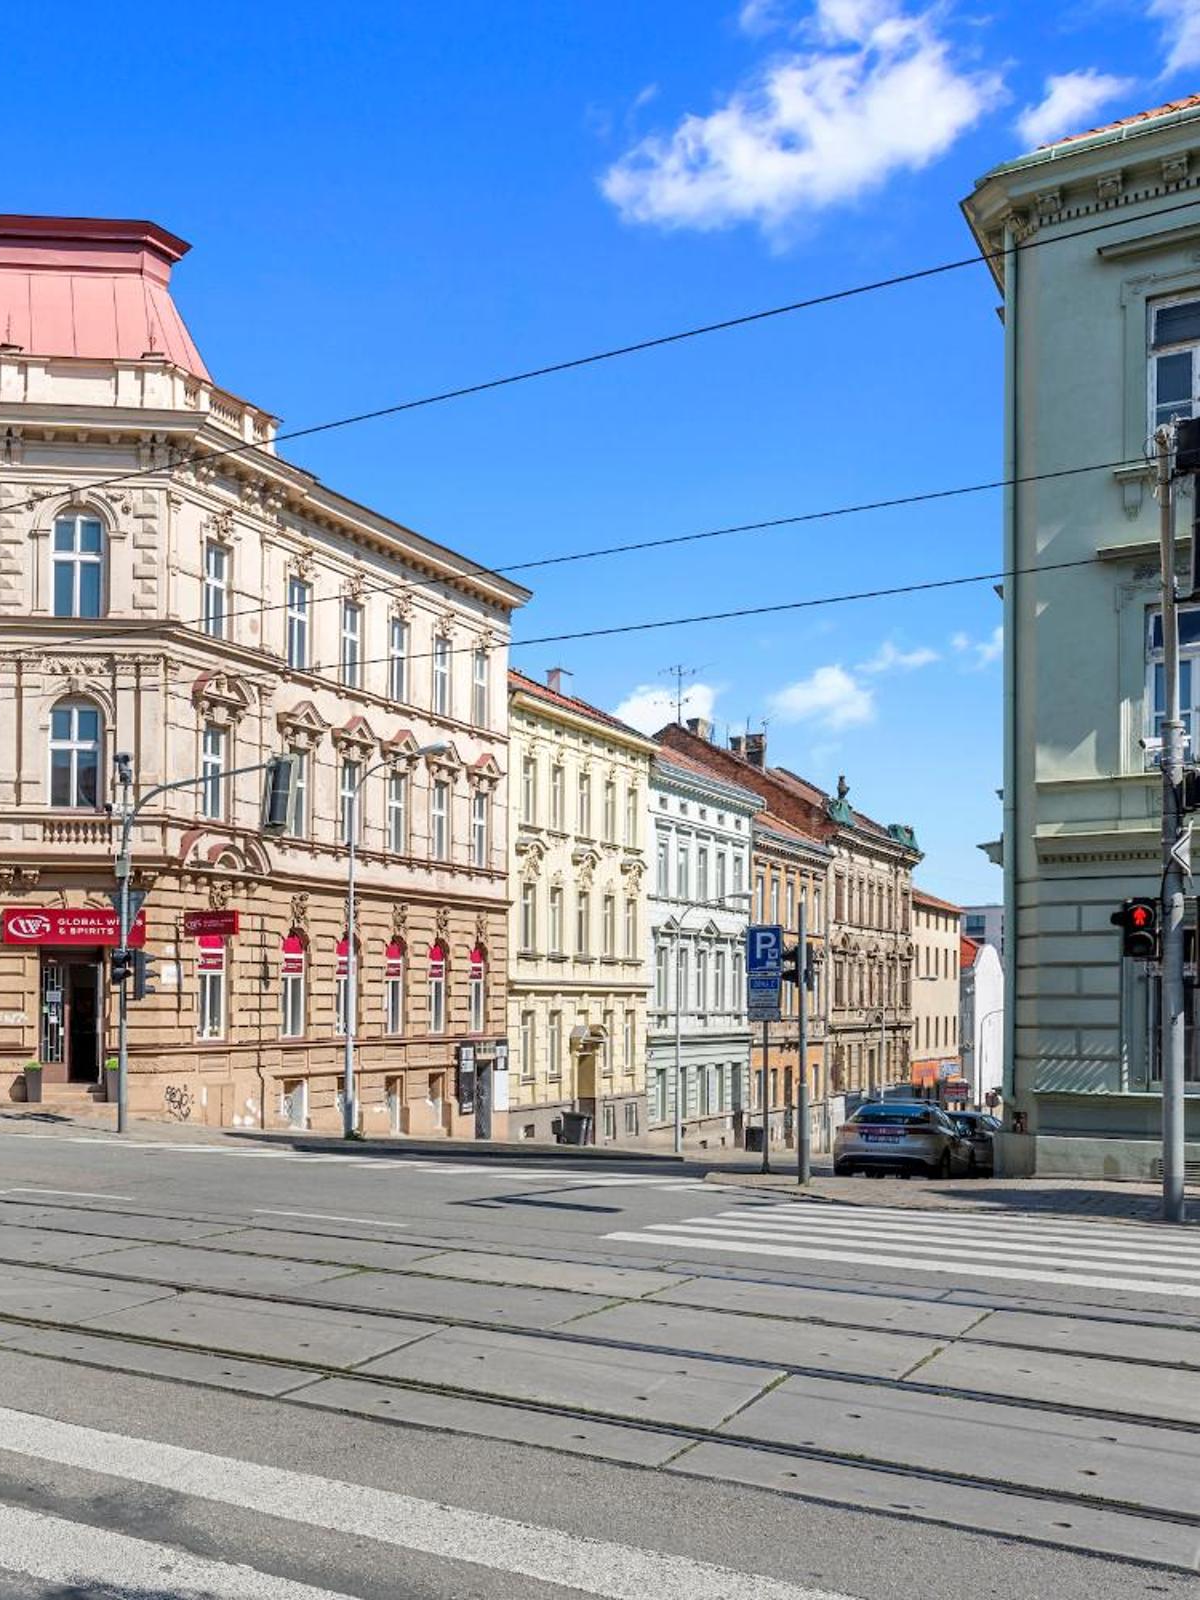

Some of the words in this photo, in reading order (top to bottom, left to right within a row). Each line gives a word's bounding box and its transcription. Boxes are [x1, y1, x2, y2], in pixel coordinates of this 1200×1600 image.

[57, 918, 103, 926] GLOBAL
[106, 918, 143, 927] WIS
[58, 927, 66, 935] &
[70, 927, 115, 935] SPIRITS
[756, 932, 777, 959] P
